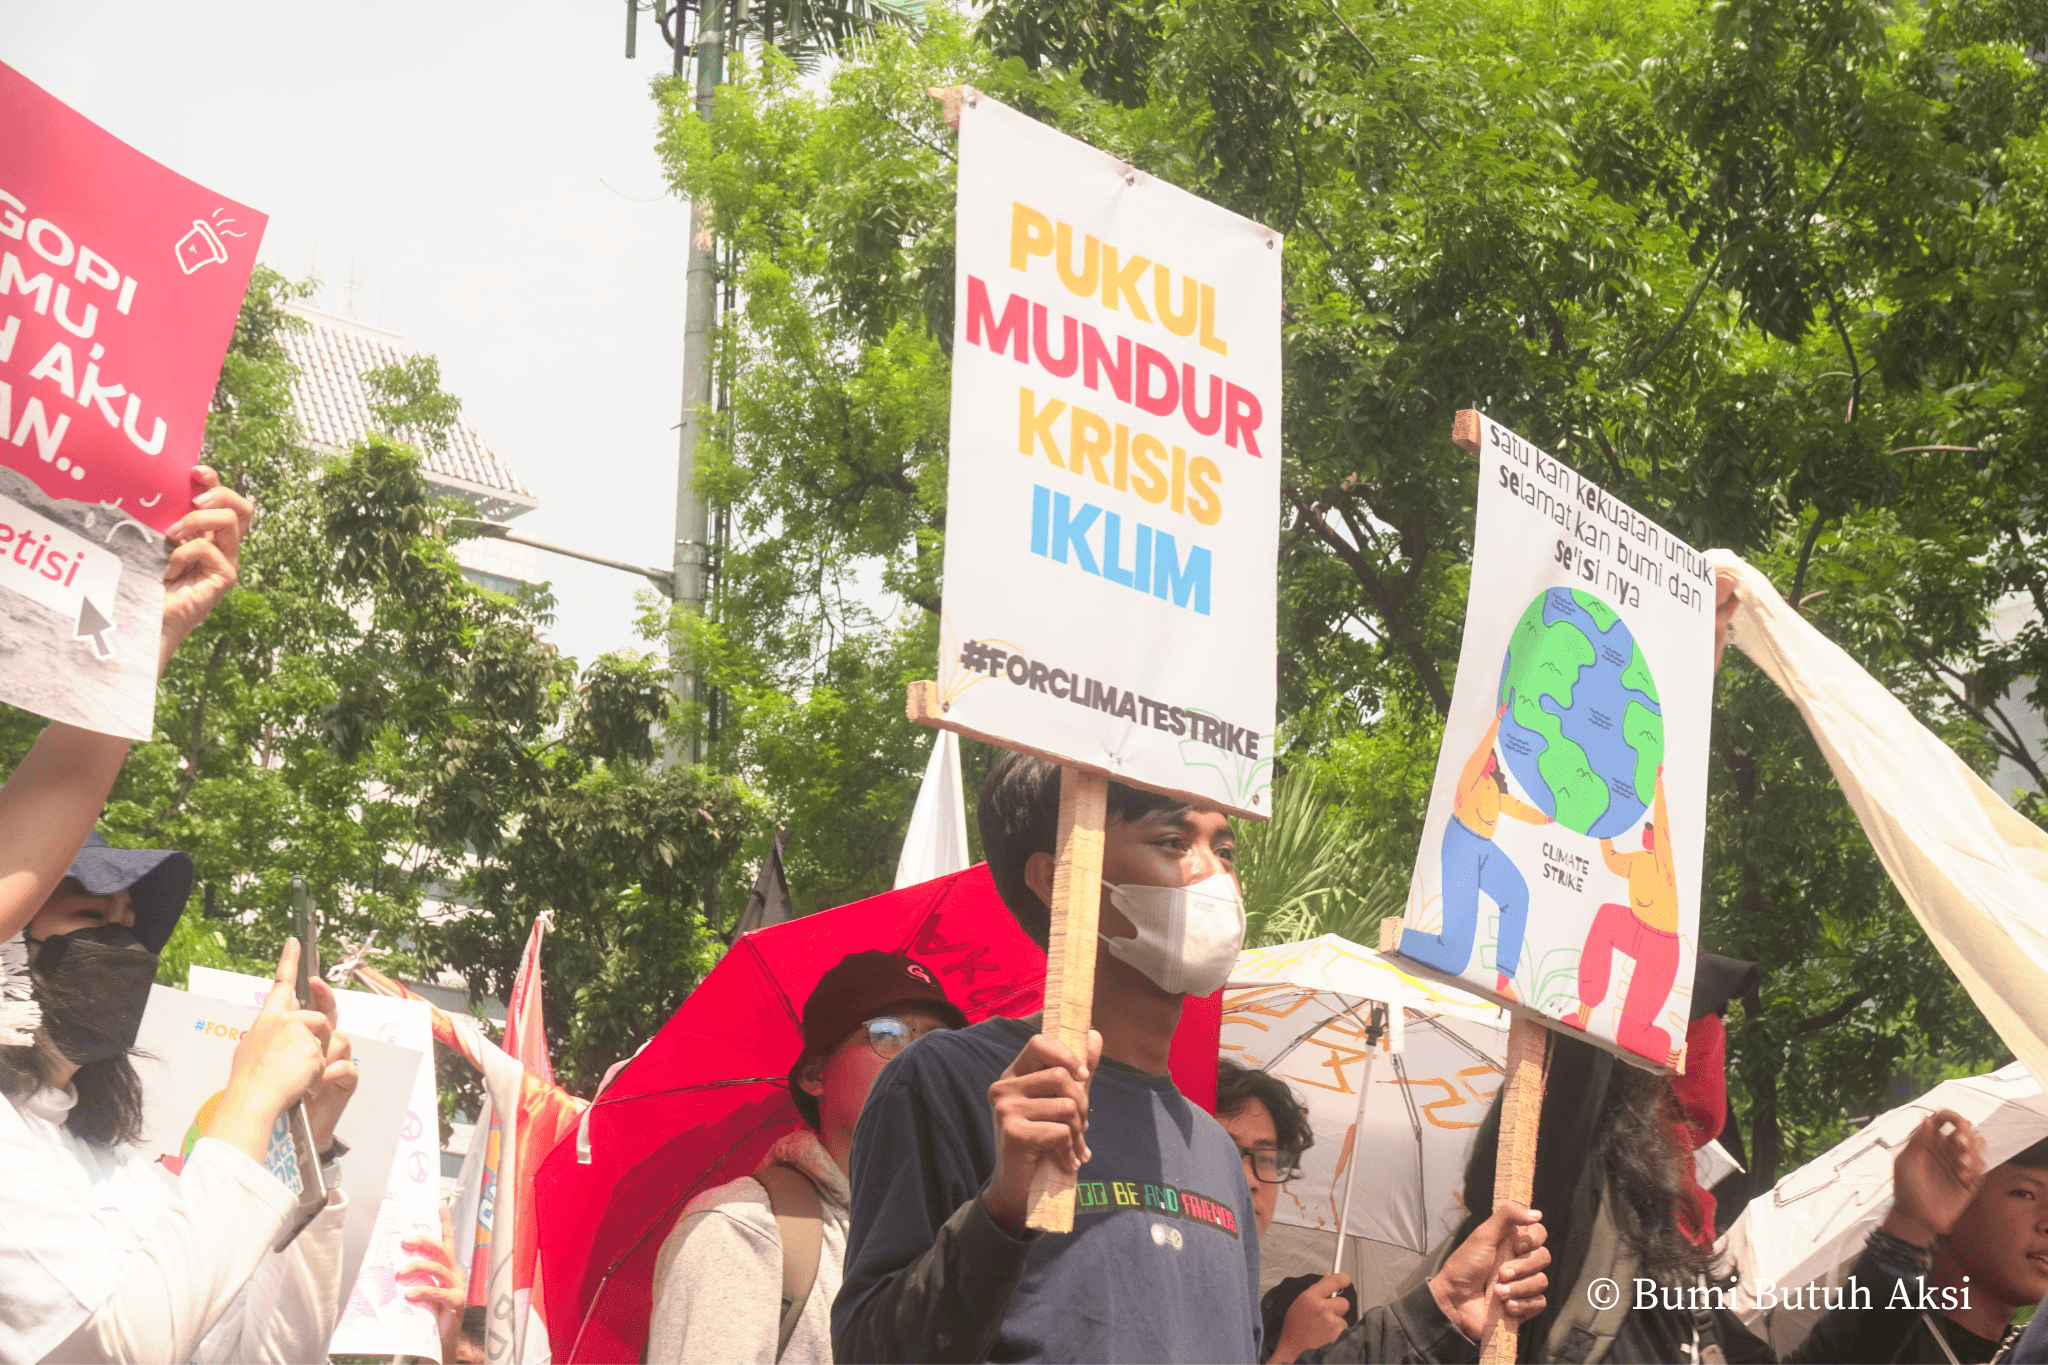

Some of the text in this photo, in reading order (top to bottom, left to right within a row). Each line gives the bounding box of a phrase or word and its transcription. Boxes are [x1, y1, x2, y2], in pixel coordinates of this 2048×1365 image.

[1009, 201, 1228, 358] PUKUL
[28, 341, 168, 456] AKU
[966, 274, 1263, 459] MUNDUR
[1018, 386, 1223, 526] KRISIS
[1490, 424, 1714, 587] satu kan kekuatan untuk
[1030, 483, 1213, 616] IKLIM
[1499, 465, 1702, 613] selamat kan bumi dan
[1607, 568, 1640, 608] nya
[960, 640, 1260, 761] #FORCLIMATESTRIKE
[1542, 842, 1590, 875] CLIMATE
[1543, 862, 1584, 893] STRIKE
[1112, 1181, 1140, 1206] BE
[1145, 1184, 1179, 1212] AND
[1181, 1193, 1237, 1233] FRIENDS
